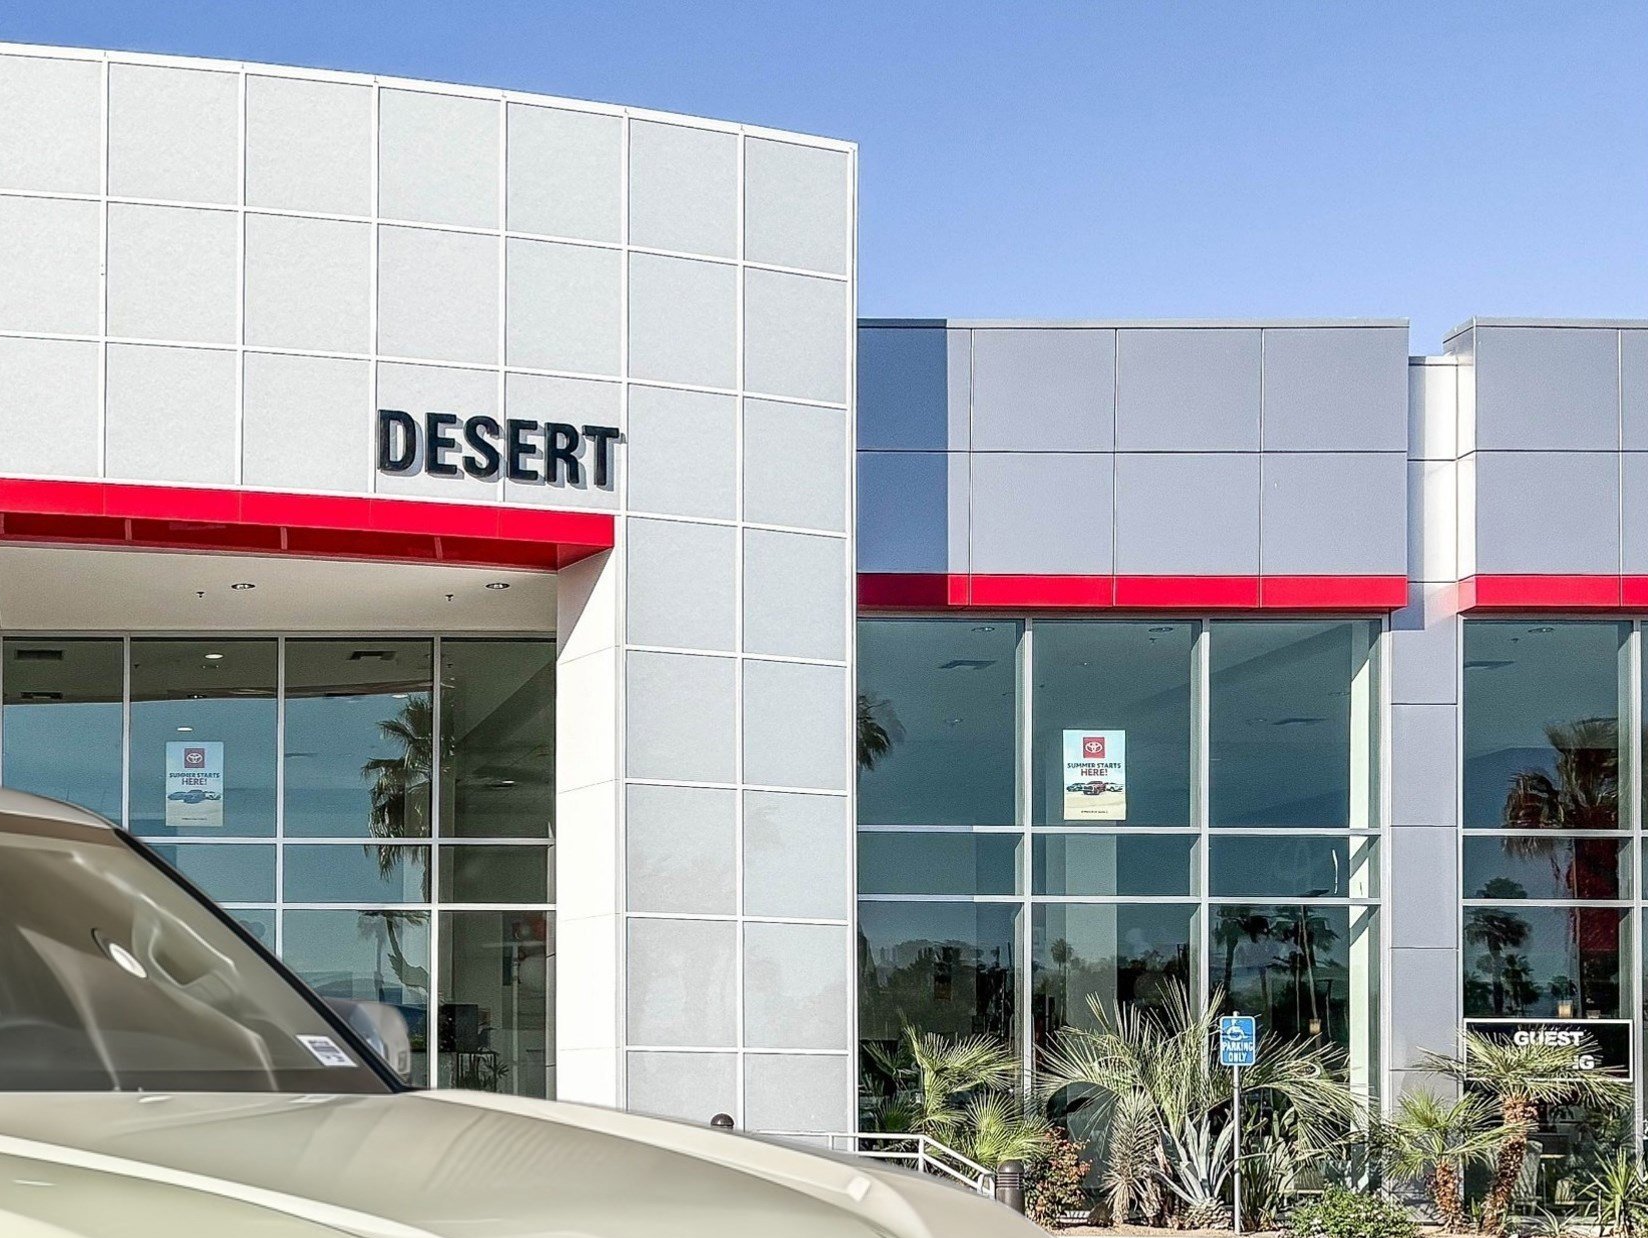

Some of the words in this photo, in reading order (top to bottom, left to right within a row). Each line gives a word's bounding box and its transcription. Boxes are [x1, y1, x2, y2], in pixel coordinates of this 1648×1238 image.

[377, 409, 620, 486] DESERT
[1080, 768, 1108, 776] HERE!
[181, 778, 207, 786] HERE!
[1513, 1030, 1585, 1047] GUEST
[1222, 1040, 1253, 1052] PARKING
[1228, 1051, 1248, 1063] ONLY
